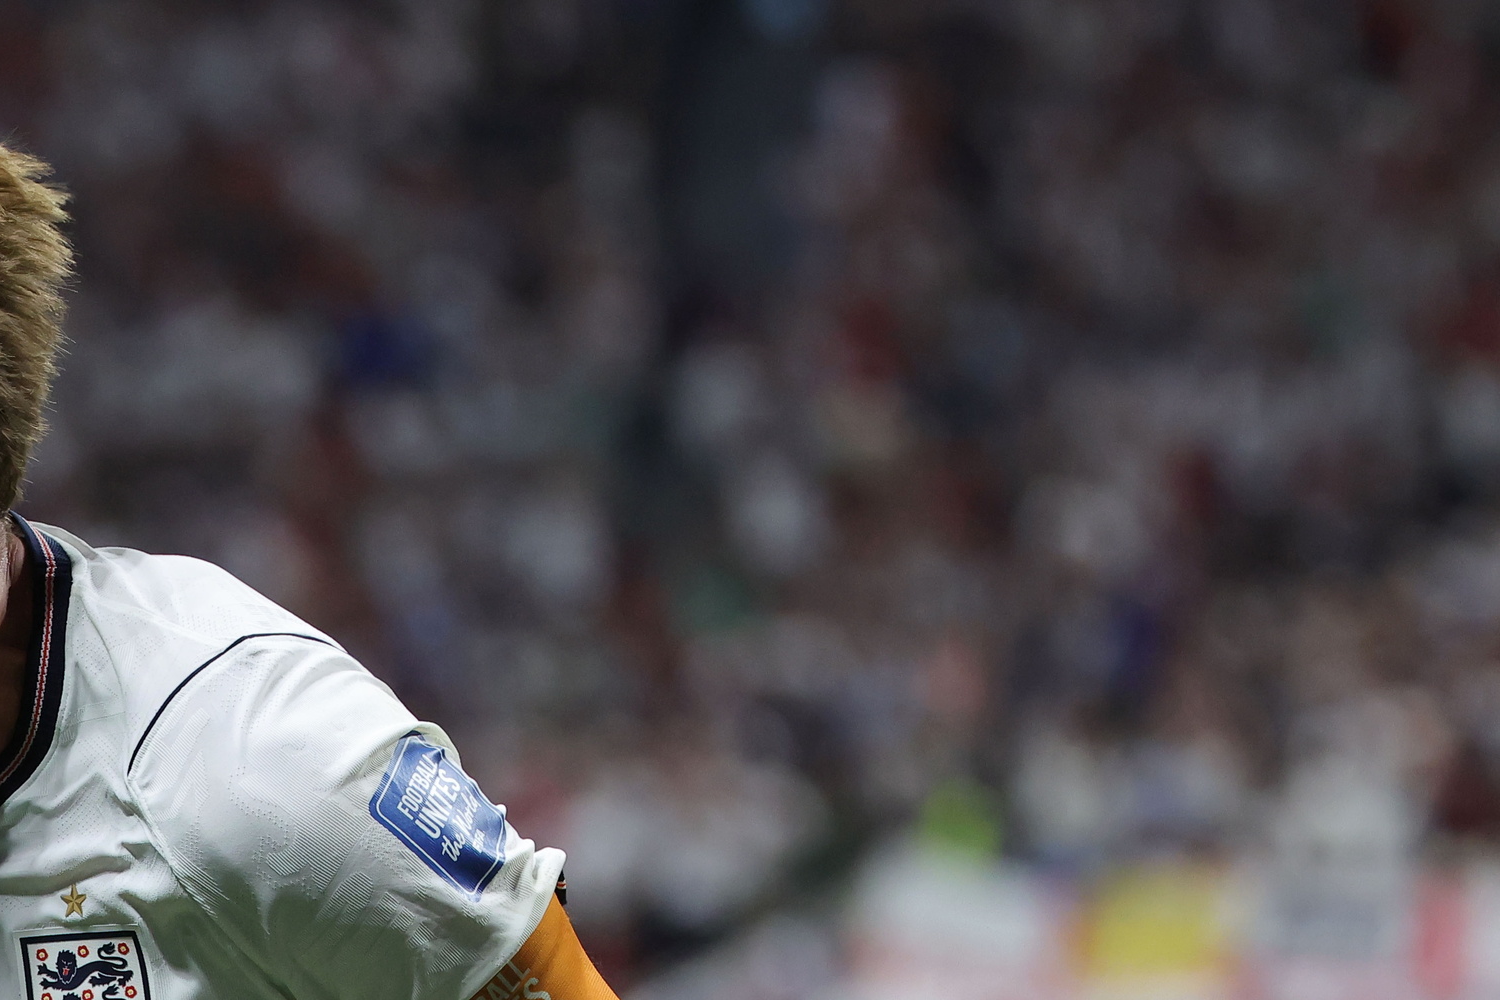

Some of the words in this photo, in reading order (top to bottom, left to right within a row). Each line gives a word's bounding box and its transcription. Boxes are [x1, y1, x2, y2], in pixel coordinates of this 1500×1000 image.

[396, 754, 438, 820] FOOTBALL
[415, 768, 461, 839] UNITES
[452, 786, 483, 836] World
[441, 829, 467, 862] the
[472, 828, 486, 853] FIFA
